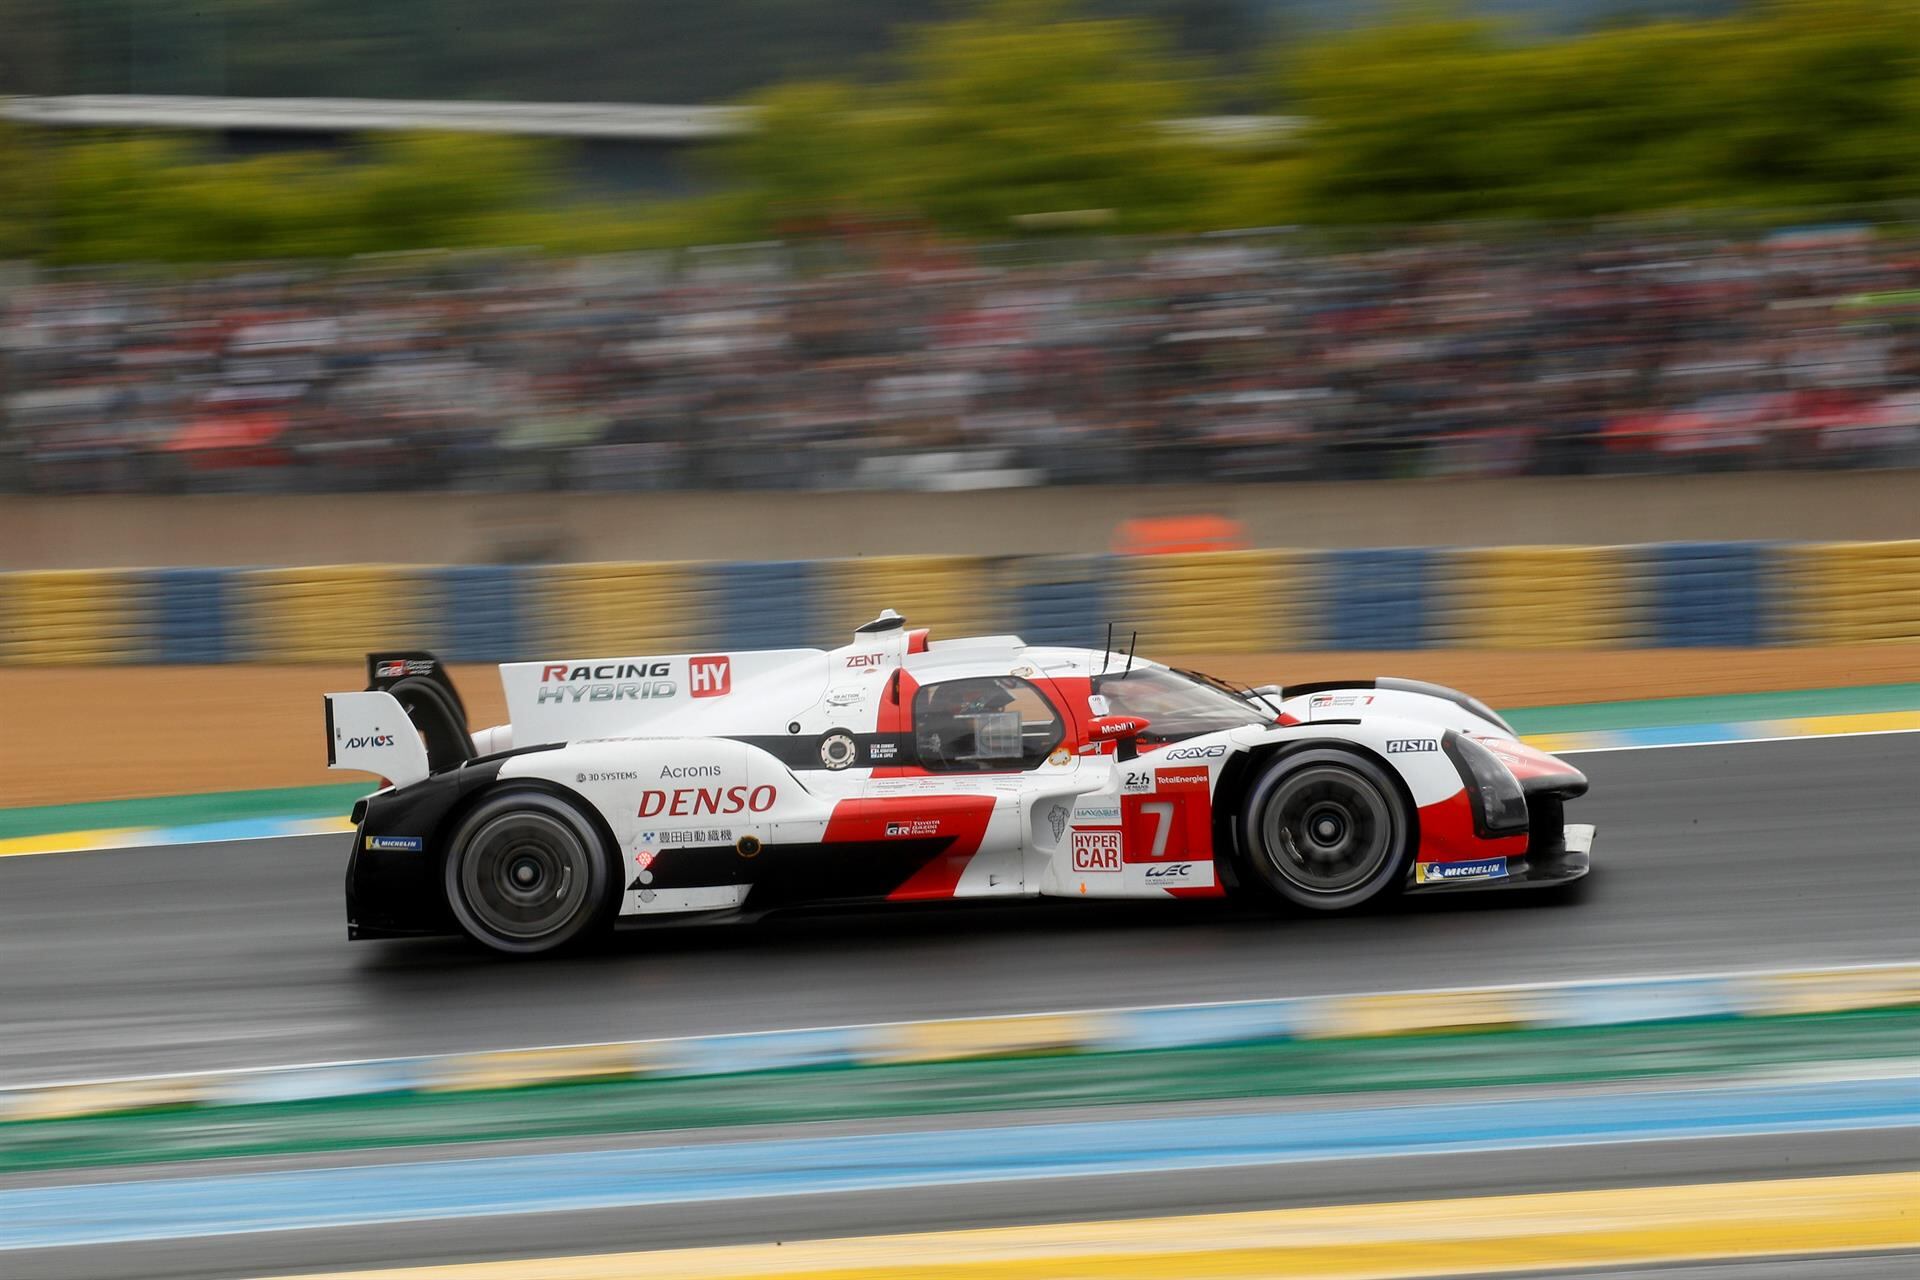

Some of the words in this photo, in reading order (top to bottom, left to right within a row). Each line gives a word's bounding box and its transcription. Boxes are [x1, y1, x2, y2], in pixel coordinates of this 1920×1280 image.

[846, 653, 884, 667] ZENT
[541, 662, 671, 682] RACING
[691, 663, 728, 691] HY
[537, 681, 677, 704] HYBRID
[1102, 723, 1127, 734] Mobil
[1167, 745, 1227, 760] RAYS
[1388, 740, 1436, 753] AISIN
[588, 773, 600, 781] 3D
[600, 771, 638, 781] SYSTEMS
[660, 765, 721, 779] Acronis
[1157, 775, 1208, 784] TotalEnergies
[637, 785, 777, 817] DENSO
[886, 827, 910, 836] GR
[1141, 802, 1174, 856] 7
[1075, 835, 1118, 848] HYPER
[1076, 848, 1118, 868] CAR
[1145, 865, 1192, 876] WEC
[1444, 864, 1500, 876] MICHELIN
